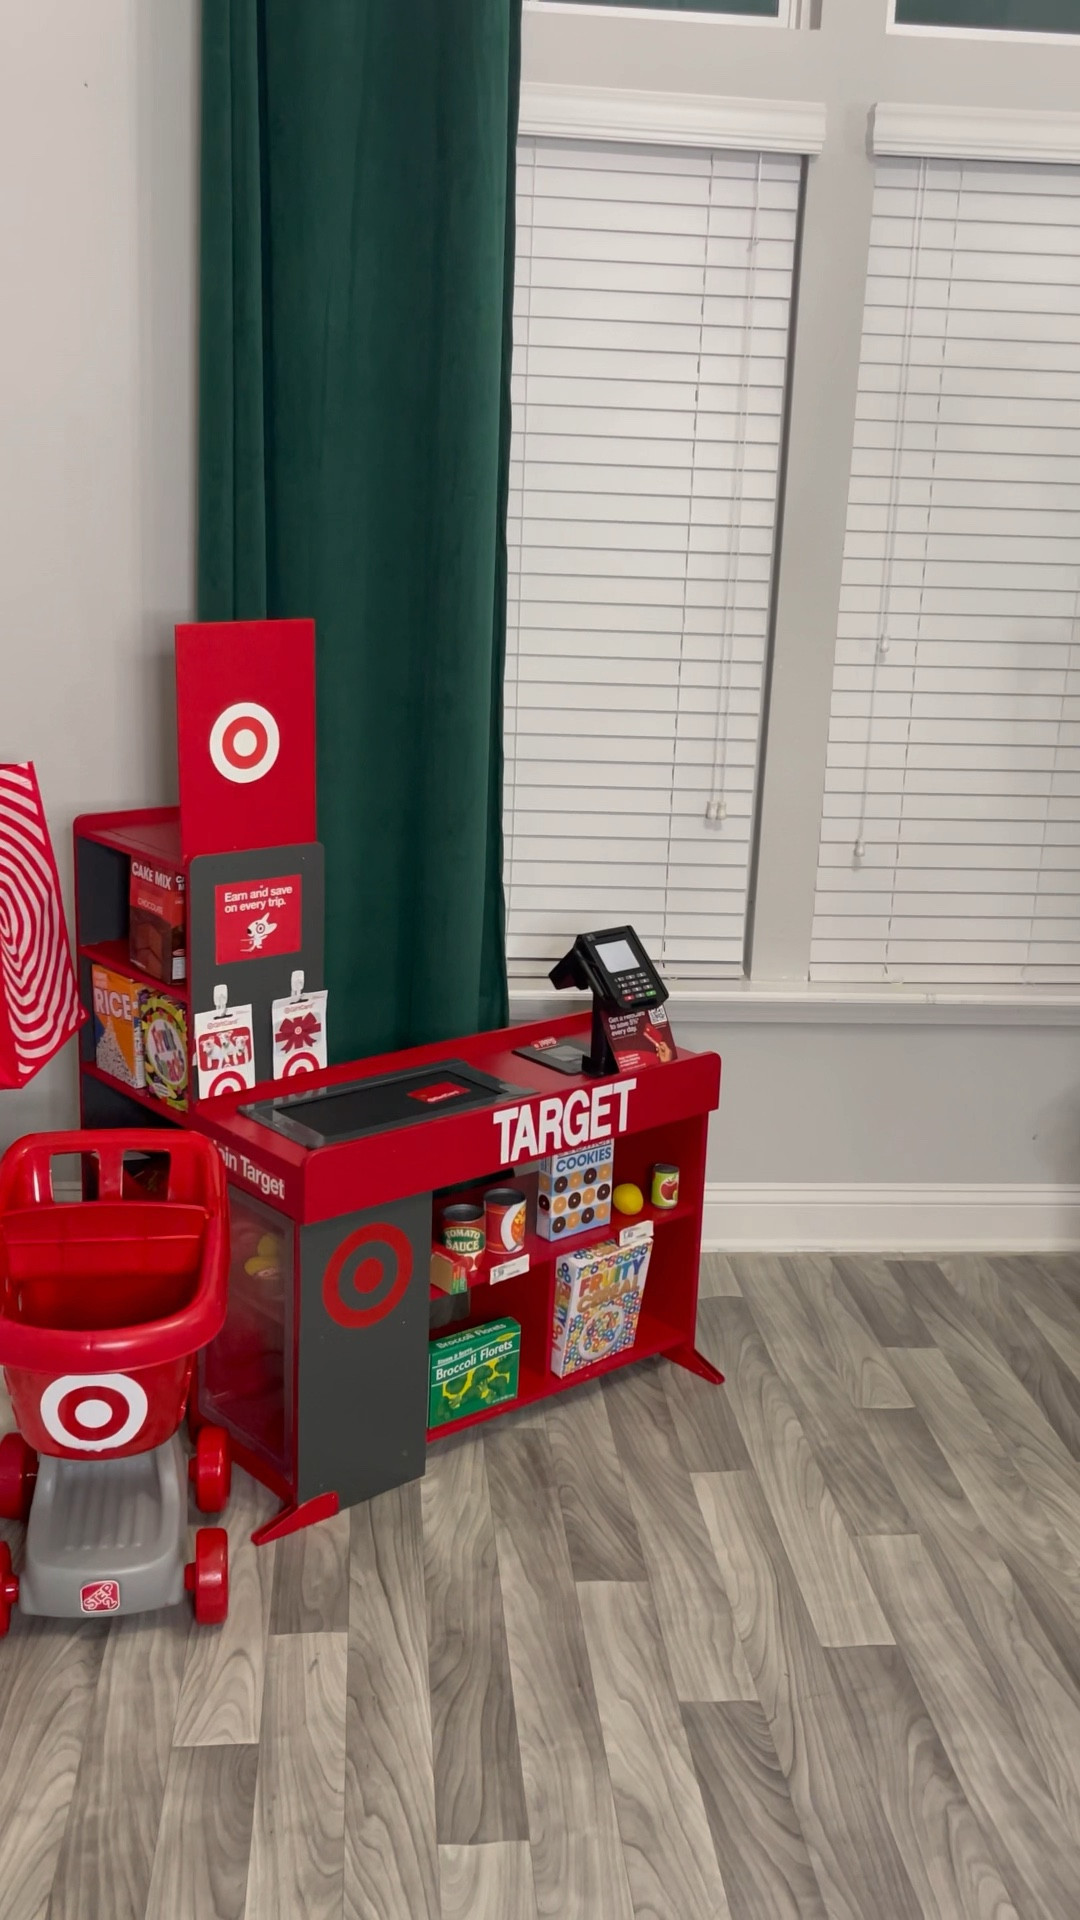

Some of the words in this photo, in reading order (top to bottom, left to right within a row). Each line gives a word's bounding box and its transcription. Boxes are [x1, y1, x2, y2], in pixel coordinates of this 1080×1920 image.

[131, 862, 153, 882] CAKE
[155, 871, 171, 890] MIX
[224, 892, 248, 902] Earn
[250, 887, 268, 899] and
[270, 886, 293, 896] save
[224, 904, 238, 913] on
[239, 900, 266, 910] every
[268, 896, 286, 908] trip.
[93, 988, 132, 1020] RICE
[493, 1078, 637, 1165] TARGET
[213, 1139, 238, 1171] in
[240, 1154, 285, 1200] Target
[556, 1147, 612, 1172] COOKIES
[444, 1228, 481, 1239] TOMATO
[445, 1239, 480, 1252] SAUCE
[579, 1256, 646, 1297] FRUITY
[436, 1333, 475, 1349] Broccoli
[474, 1324, 506, 1336] Florets
[436, 1353, 477, 1380] Broccoli
[480, 1341, 513, 1361] Florets
[84, 1582, 114, 1609] STEP
[103, 1597, 118, 1608] 2
